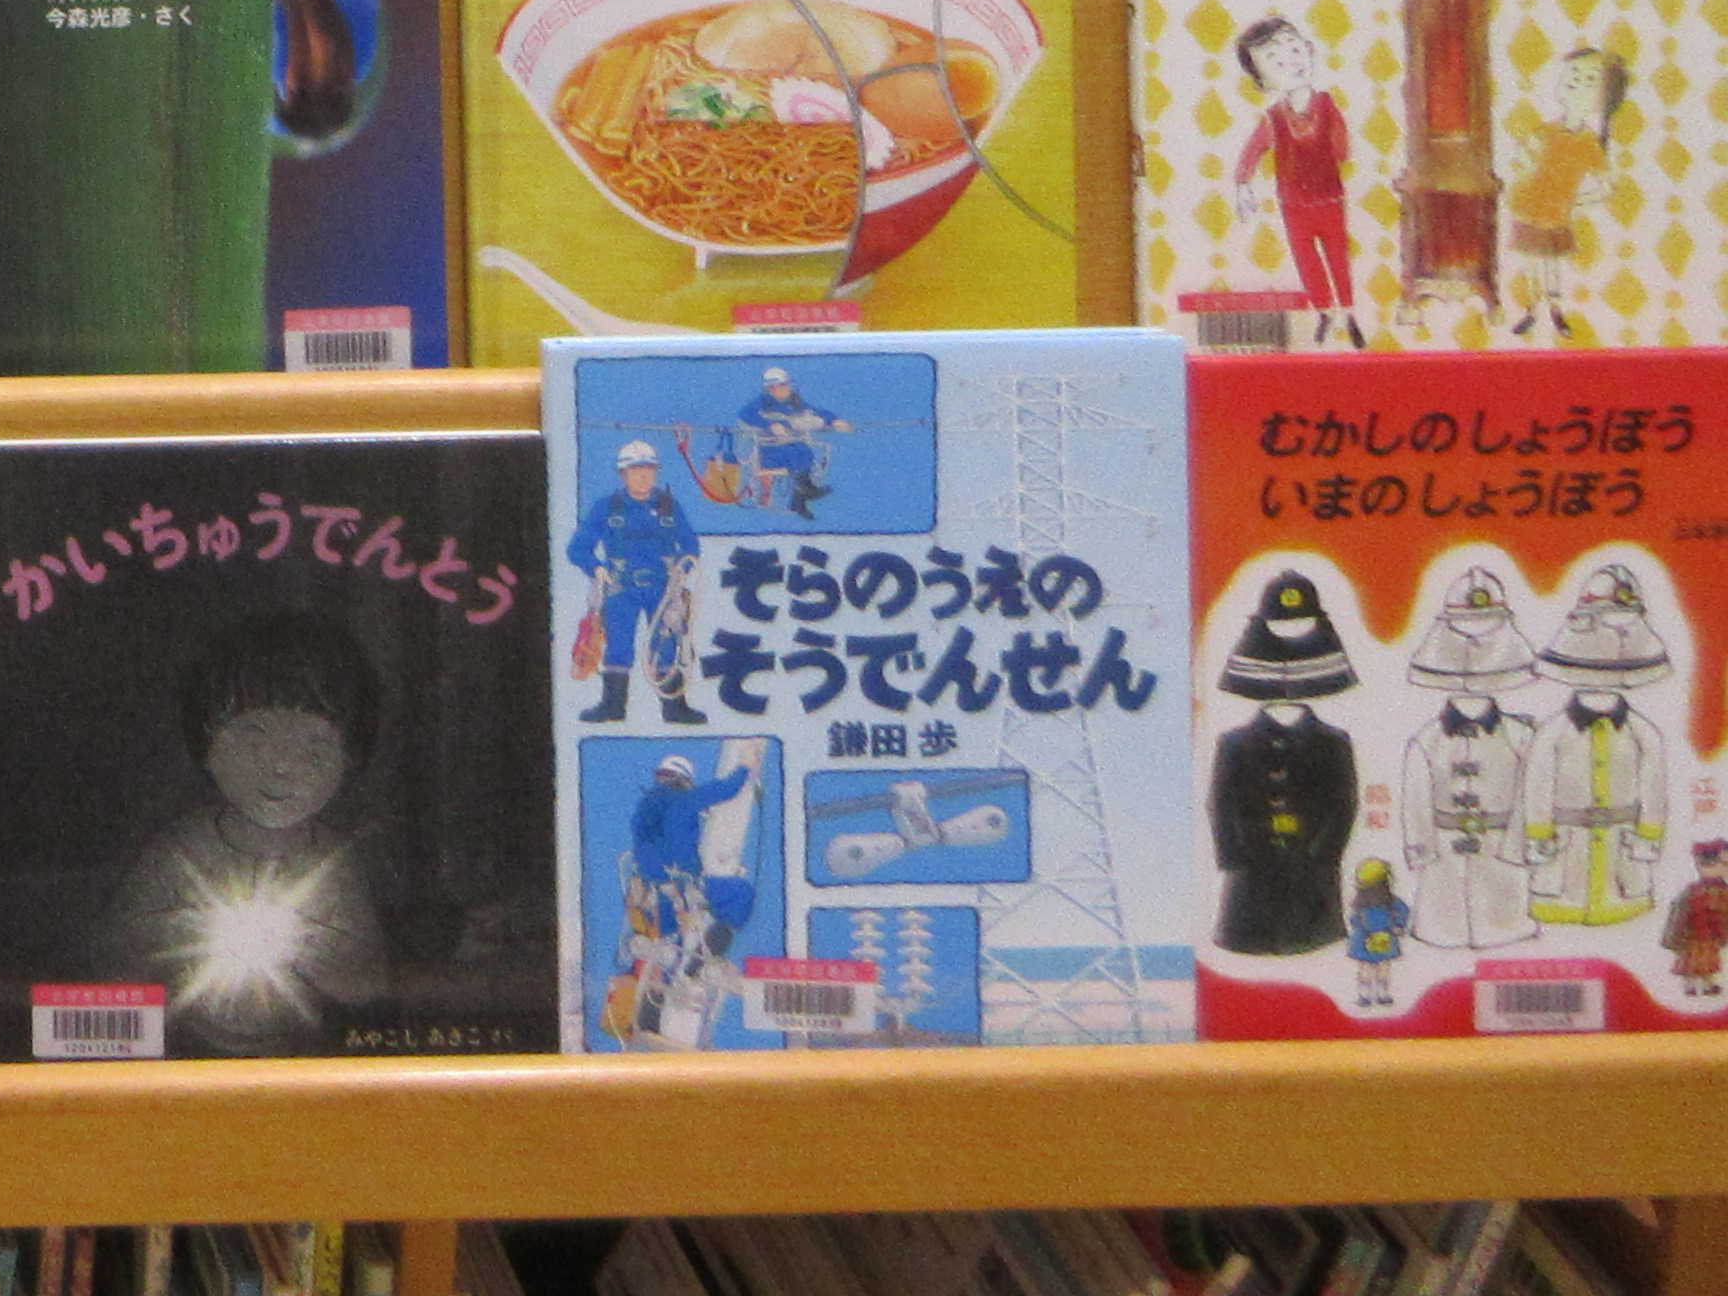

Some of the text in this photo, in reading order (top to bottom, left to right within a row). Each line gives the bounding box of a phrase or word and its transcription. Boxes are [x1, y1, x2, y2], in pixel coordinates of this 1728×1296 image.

[1258, 406, 1695, 459] むかしのしょうぼう
[1258, 470, 1645, 521] いまのしょうぼう
[0, 491, 520, 626] かいちゅうでんとう
[719, 544, 1106, 621] そらのうえの
[700, 626, 1157, 714] そうでんせん
[826, 720, 960, 758] 鎌田 歩
[345, 1027, 419, 1049] みやこし
[427, 1026, 481, 1048] あきこ
